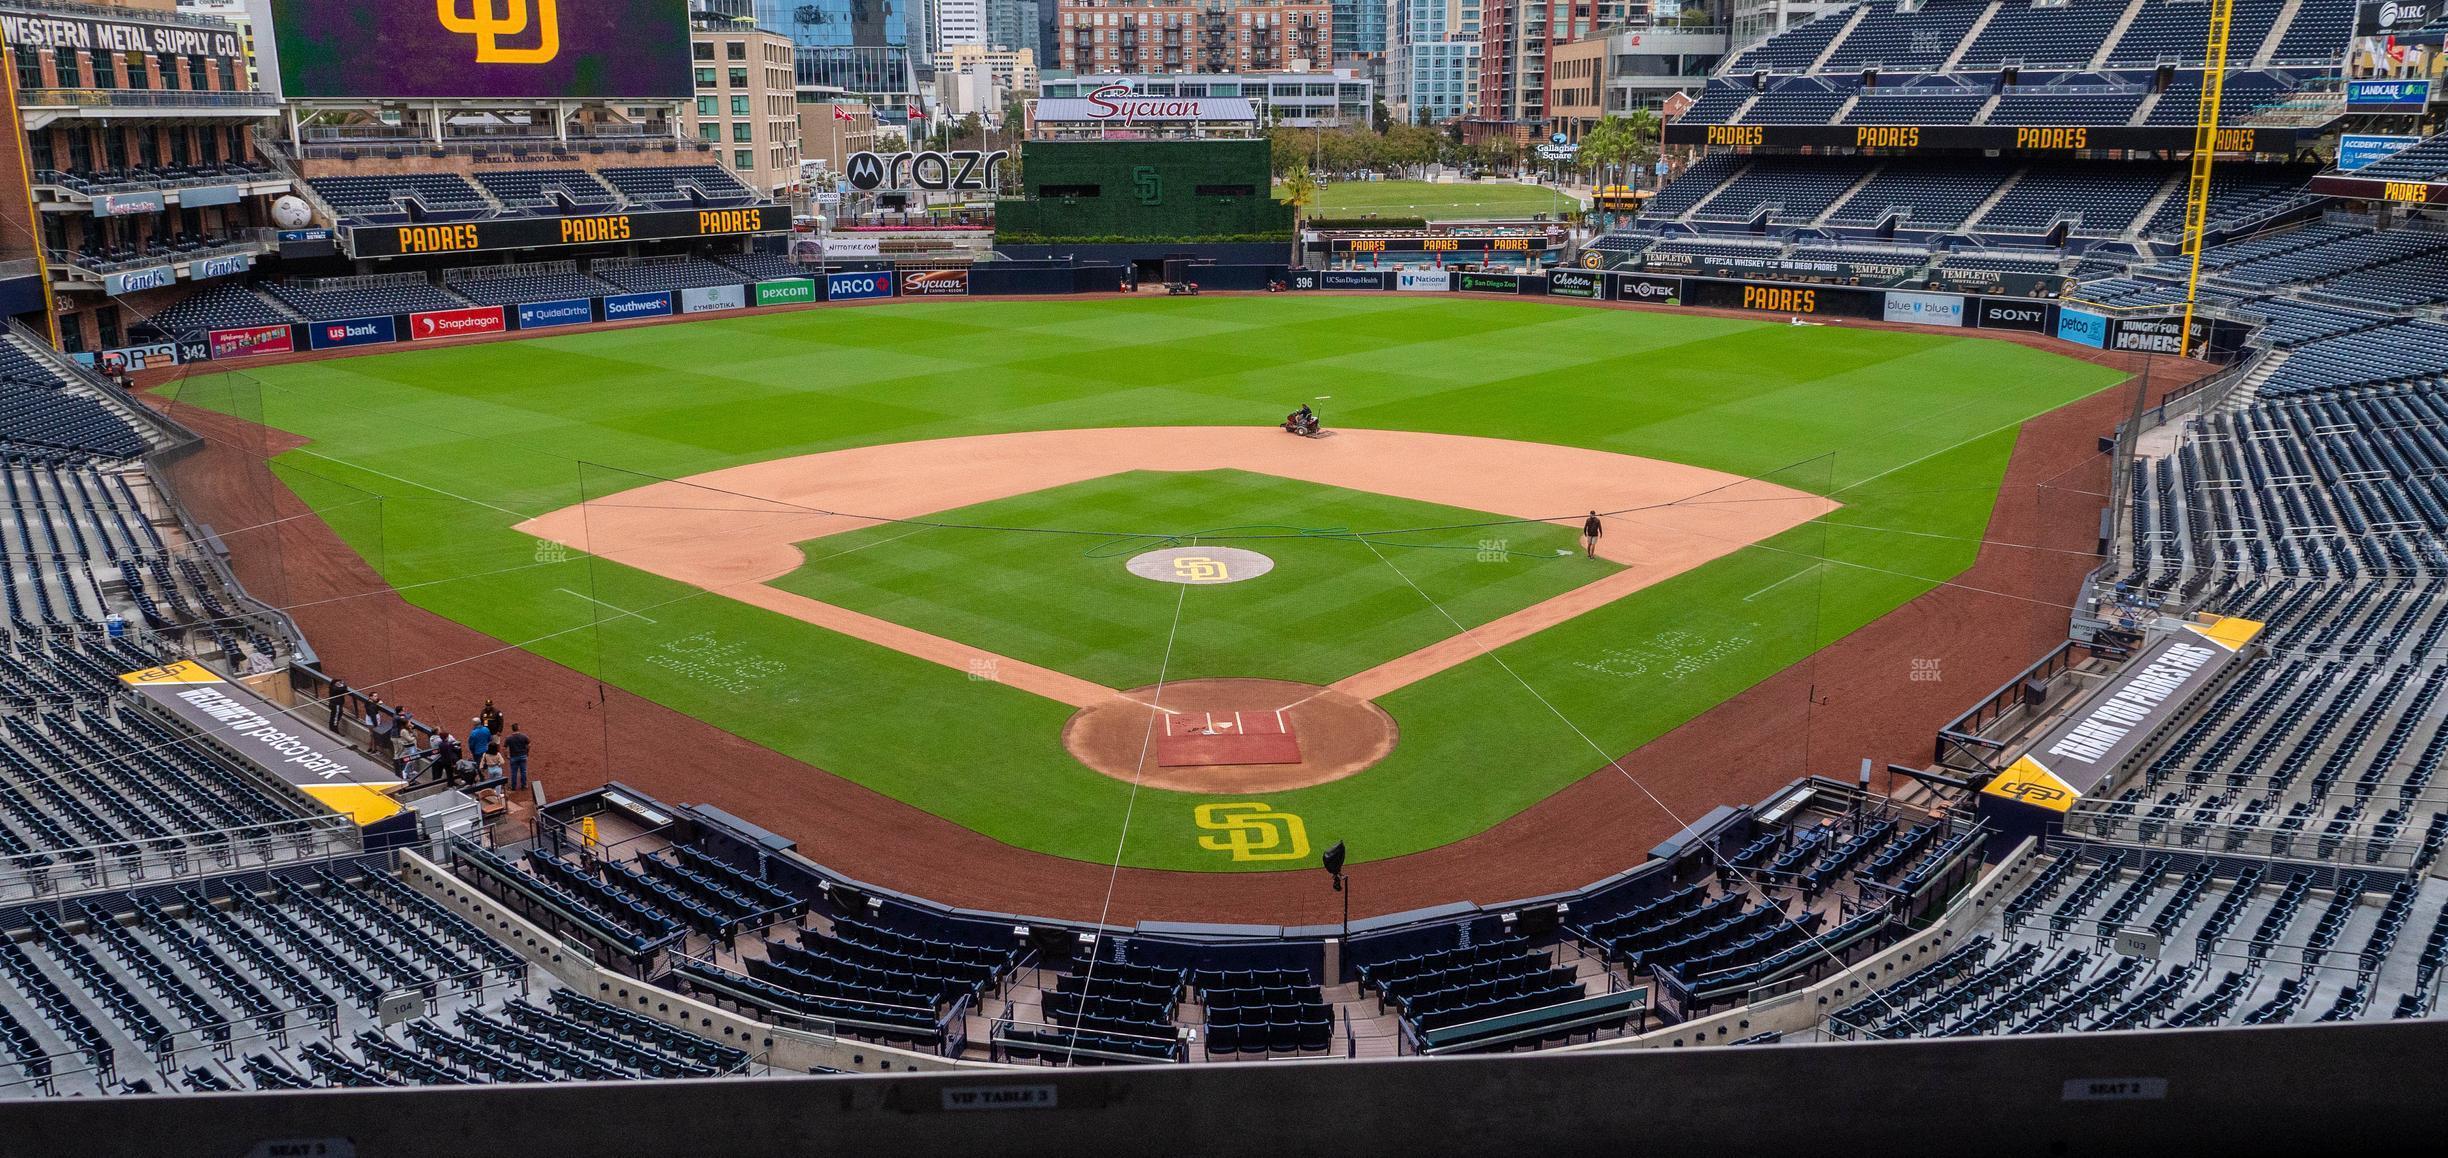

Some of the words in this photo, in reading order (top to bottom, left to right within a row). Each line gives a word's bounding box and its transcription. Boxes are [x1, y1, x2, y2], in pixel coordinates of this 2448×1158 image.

[2397, 5, 2426, 19] MRC
[0, 15, 90, 47] WESTERN
[97, 24, 152, 51] METAL
[154, 29, 212, 56] SUPPLY
[215, 34, 240, 57] CO.
[2360, 84, 2400, 96] LANDCARE
[1086, 84, 1202, 128] Sycuan
[1707, 126, 1763, 145] PADRES
[1857, 127, 1919, 147] PADRES
[2017, 128, 2087, 149] PADRES
[2216, 129, 2256, 152] ADRES
[1537, 144, 1578, 154] Gallagher
[1542, 152, 1572, 161] Square
[889, 150, 1009, 190] razr
[2384, 182, 2428, 203] PADRES
[561, 216, 631, 243] PADRES
[700, 210, 762, 234] PADRES
[400, 224, 479, 253] PADRES
[829, 243, 877, 251] NITTOTIRE.COM
[1351, 240, 1386, 251] PADRES
[1494, 239, 1529, 250] PADRES
[203, 256, 241, 277] Canel's
[1645, 253, 1693, 264] TEMPLETON
[1704, 257, 1734, 266] OFFICIAL
[1735, 258, 1765, 268] WHISKEY
[1780, 261, 1793, 269] SAN
[1794, 262, 1813, 270] DIEGO
[1813, 262, 1838, 272] PADRES
[1416, 275, 1447, 283] National
[1849, 264, 1905, 277] TEMPLETON
[1941, 269, 2001, 282] TEMPLETON
[120, 269, 165, 293] Canel's
[831, 278, 875, 295] ARCO
[905, 272, 961, 294] Sycuan
[1296, 276, 1313, 289] 396
[1486, 280, 1503, 288] Diego
[1504, 280, 1516, 288] Zoo
[1553, 273, 1591, 286] Chosen
[1624, 281, 1674, 298] EVOTEK
[57, 296, 75, 311] 336
[609, 298, 661, 313] Southwest
[693, 302, 735, 311] CYMBIOTIKA
[1743, 285, 1816, 313] PADRES
[1887, 300, 1911, 311] blue
[1925, 303, 1949, 313] blue
[536, 306, 588, 320] QuidelOrtho
[1989, 308, 2042, 323] SONY
[330, 326, 345, 338] us
[346, 323, 377, 337] bank
[438, 315, 499, 332] Snapdragon
[2061, 316, 2089, 334] petco
[2122, 320, 2159, 331] HUNGRY
[2160, 323, 2179, 334] FOR
[2116, 332, 2183, 352] HOMERS
[182, 344, 207, 361] 342
[1173, 556, 1230, 581] SD
[2155, 642, 2216, 672] FANS
[2114, 664, 2192, 707] PADRES
[176, 687, 257, 722] WELCOME
[2090, 698, 2152, 727] YOU
[226, 715, 271, 731] TO
[240, 726, 311, 756] petco
[2048, 718, 2130, 764] THANK
[284, 751, 351, 780] park
[1194, 801, 1311, 862] SD
[2128, 939, 2146, 951] 103
[394, 1001, 413, 1014] 104
